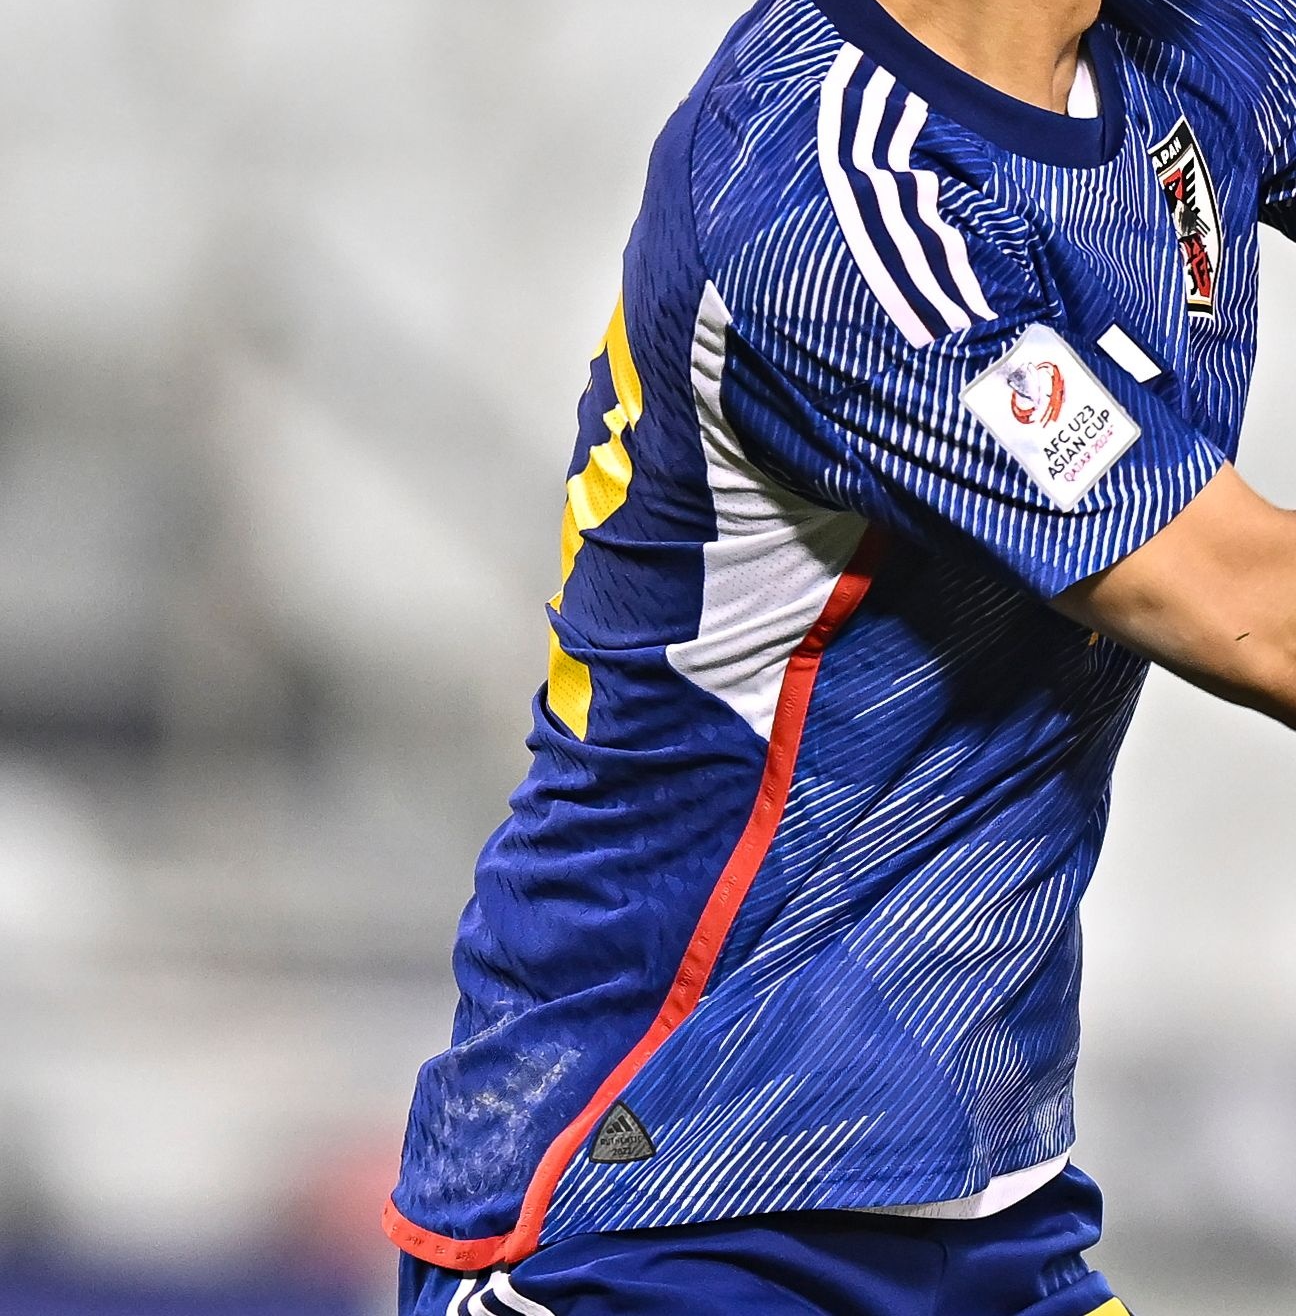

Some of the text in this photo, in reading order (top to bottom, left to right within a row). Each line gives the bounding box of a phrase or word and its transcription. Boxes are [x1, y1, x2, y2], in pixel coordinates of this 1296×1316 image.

[1151, 136, 1182, 166] APAN
[1043, 404, 1096, 462] AFC U23
[1047, 409, 1110, 481] ASIAN CUP
